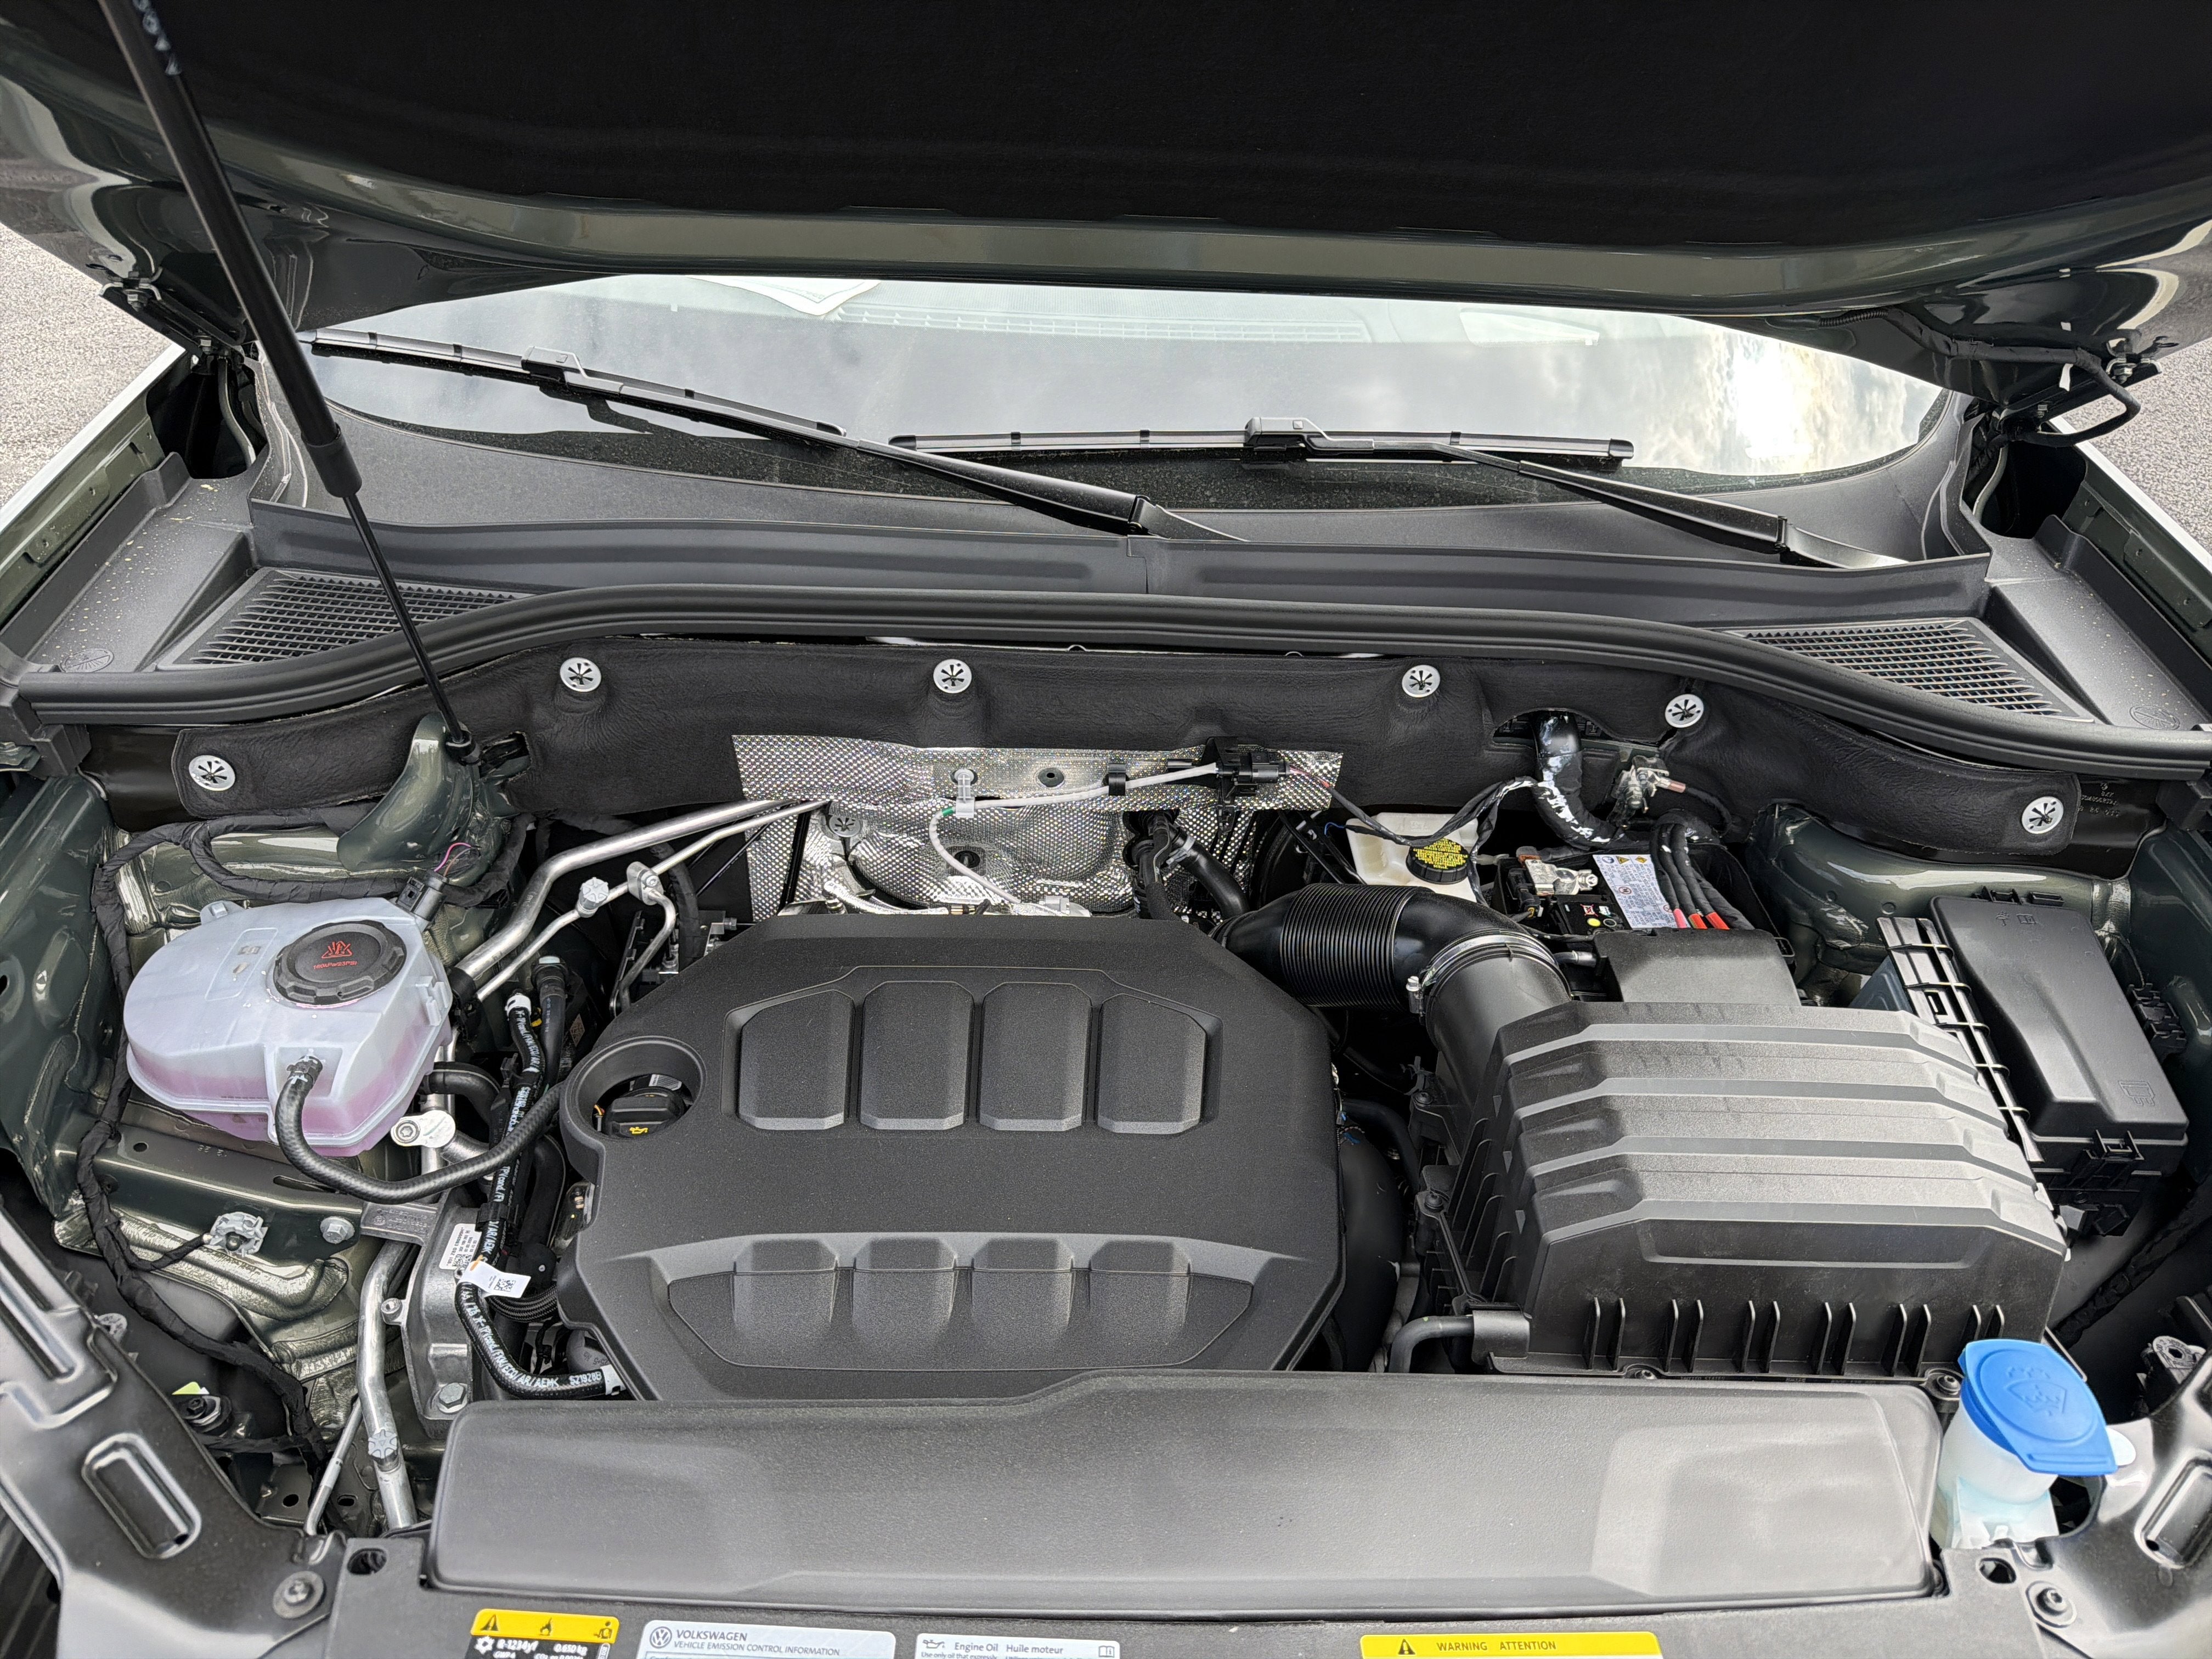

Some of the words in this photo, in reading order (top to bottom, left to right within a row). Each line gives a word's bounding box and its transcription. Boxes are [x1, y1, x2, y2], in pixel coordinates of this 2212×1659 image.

[676, 1629, 748, 1641] VOLKSWAGEN
[674, 1640, 706, 1650] VEHICLE
[707, 1641, 745, 1651] EMISSION
[747, 1644, 783, 1652] CONTROL
[785, 1646, 840, 1656] INFORMATION
[955, 1642, 984, 1653] Engine
[986, 1643, 998, 1651] Oil
[1006, 1644, 1029, 1653] Huile
[1031, 1645, 1063, 1654] moteur
[1436, 1641, 1488, 1651] WARNING
[1499, 1640, 1557, 1650] ATTENTION
